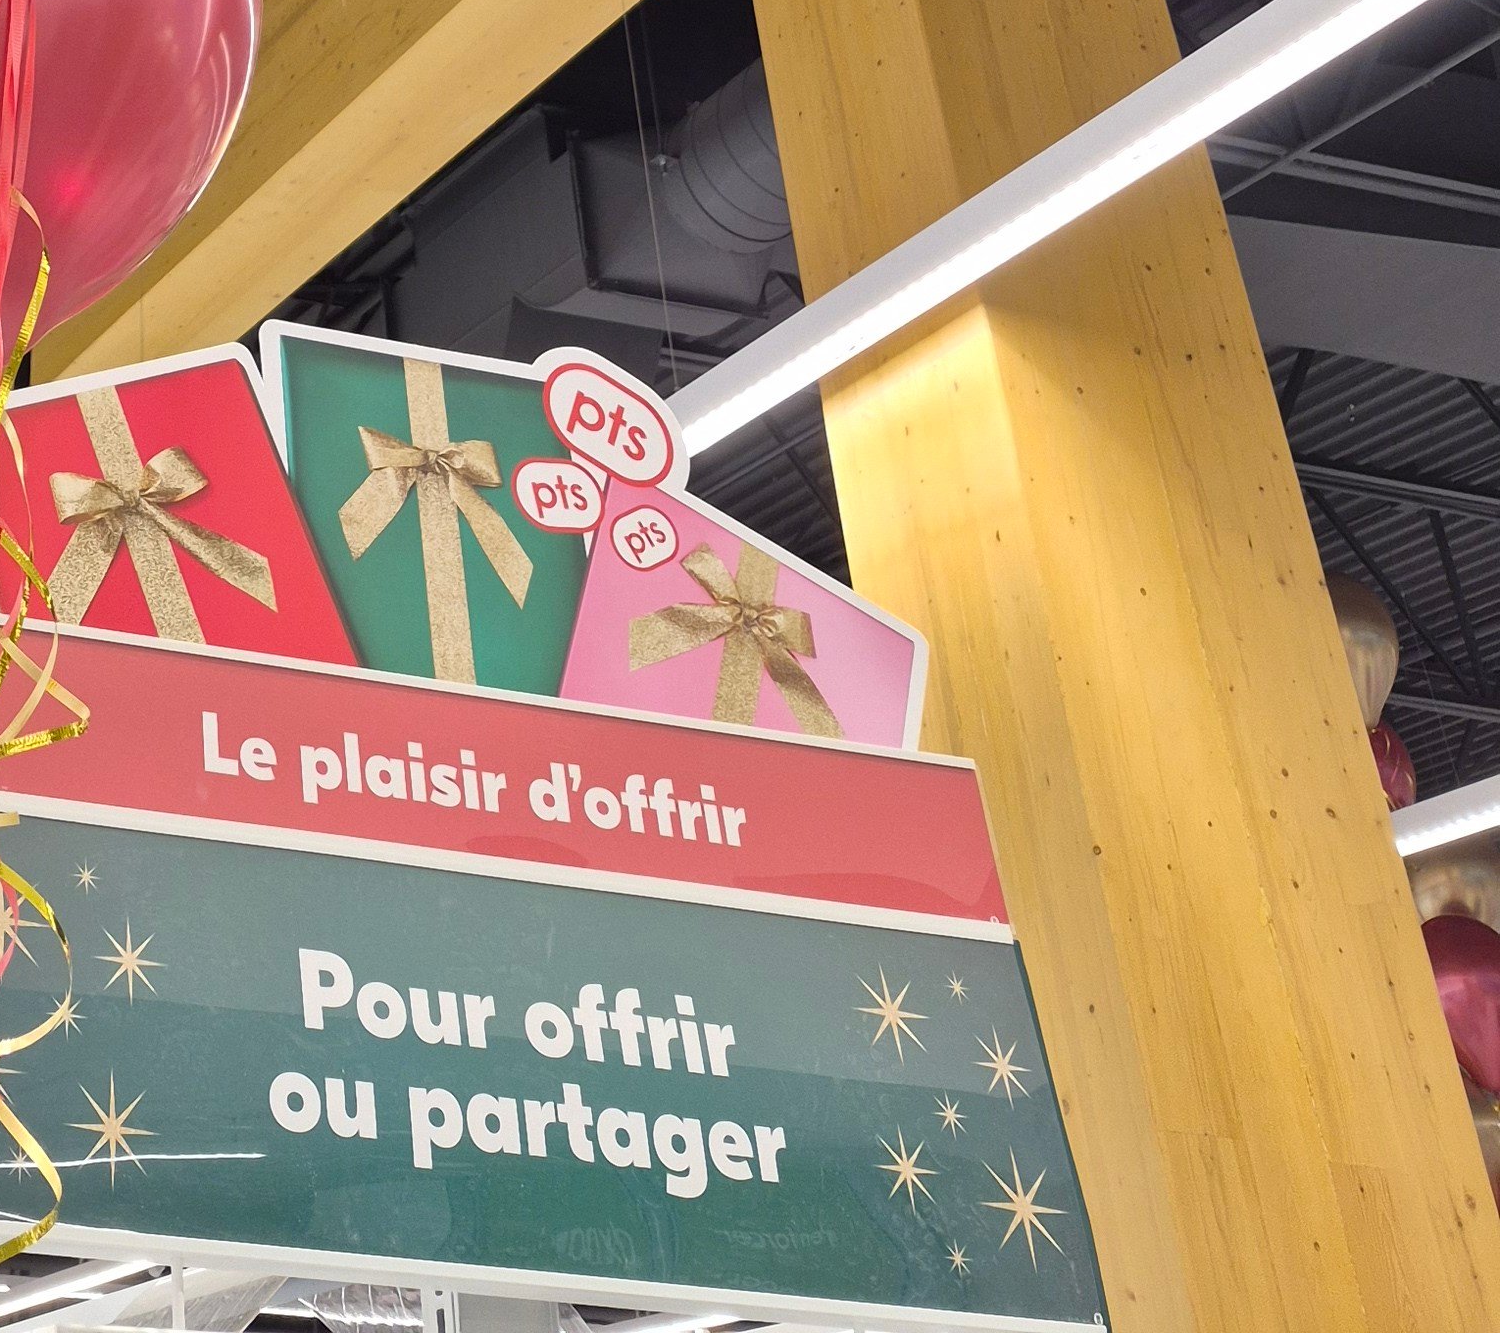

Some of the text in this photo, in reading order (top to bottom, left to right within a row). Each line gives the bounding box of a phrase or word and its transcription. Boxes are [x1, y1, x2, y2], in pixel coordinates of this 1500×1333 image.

[566, 390, 648, 461] pts
[531, 474, 588, 519] pts
[624, 520, 667, 564] pts
[201, 711, 746, 847] Le plaisir d'offrir
[299, 947, 736, 1078] Pour offrir
[268, 1071, 787, 1199] ou partager
